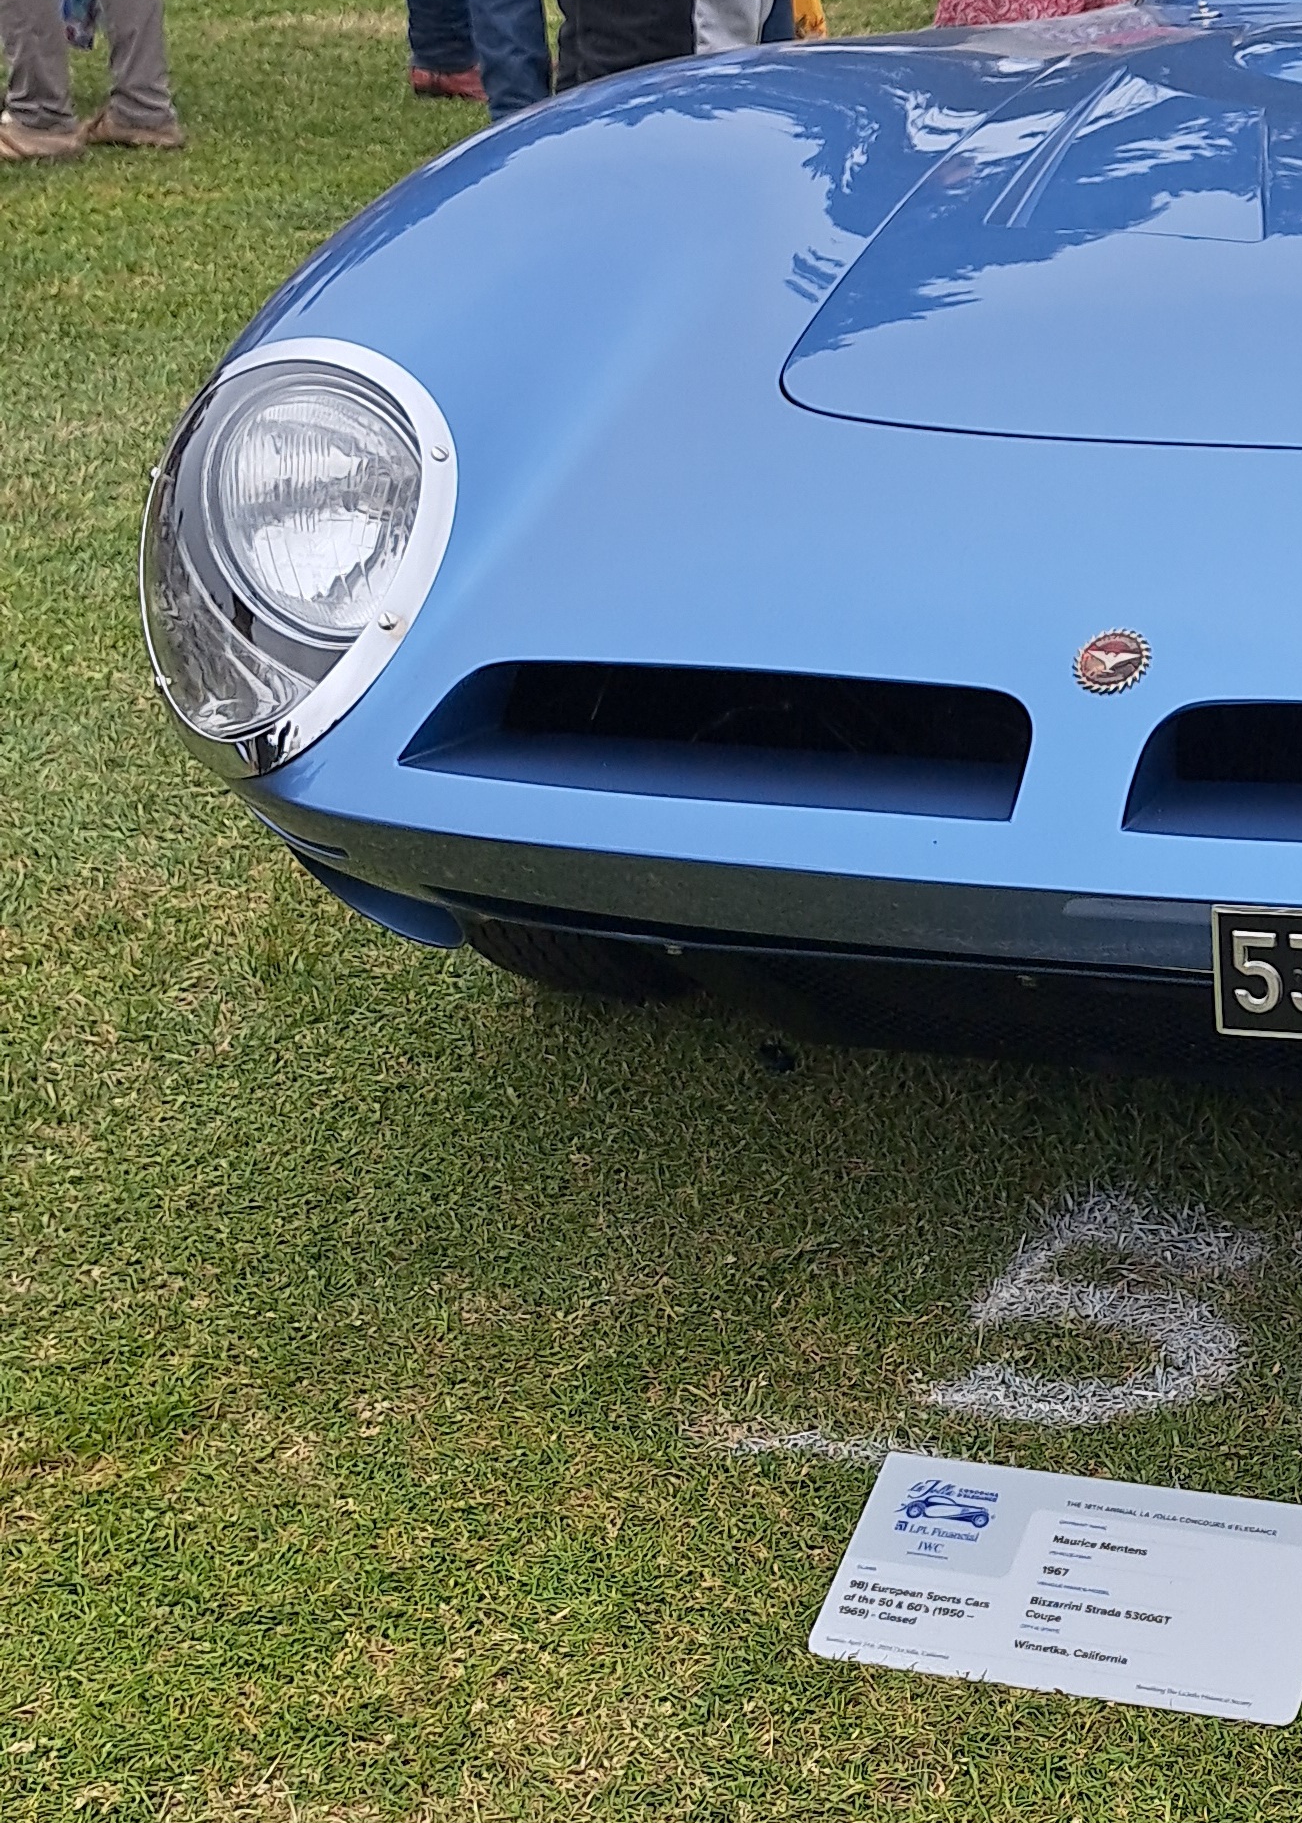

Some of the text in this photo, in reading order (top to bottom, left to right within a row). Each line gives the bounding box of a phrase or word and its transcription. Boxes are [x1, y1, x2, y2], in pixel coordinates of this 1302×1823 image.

[917, 1540, 944, 1554] IWC
[1052, 1534, 1098, 1550] Maurice
[1042, 1565, 1070, 1577] 1967
[870, 1582, 924, 1599] European
[926, 1591, 962, 1605] Sports
[964, 1597, 990, 1609] Cars
[857, 1595, 876, 1605] the
[877, 1597, 894, 1608] 50
[932, 1606, 965, 1619] (1950
[1084, 1604, 1122, 1618] Strada
[878, 1611, 918, 1625] Closed
[1025, 1609, 1062, 1624] Coupe
[1073, 1648, 1129, 1665] California
